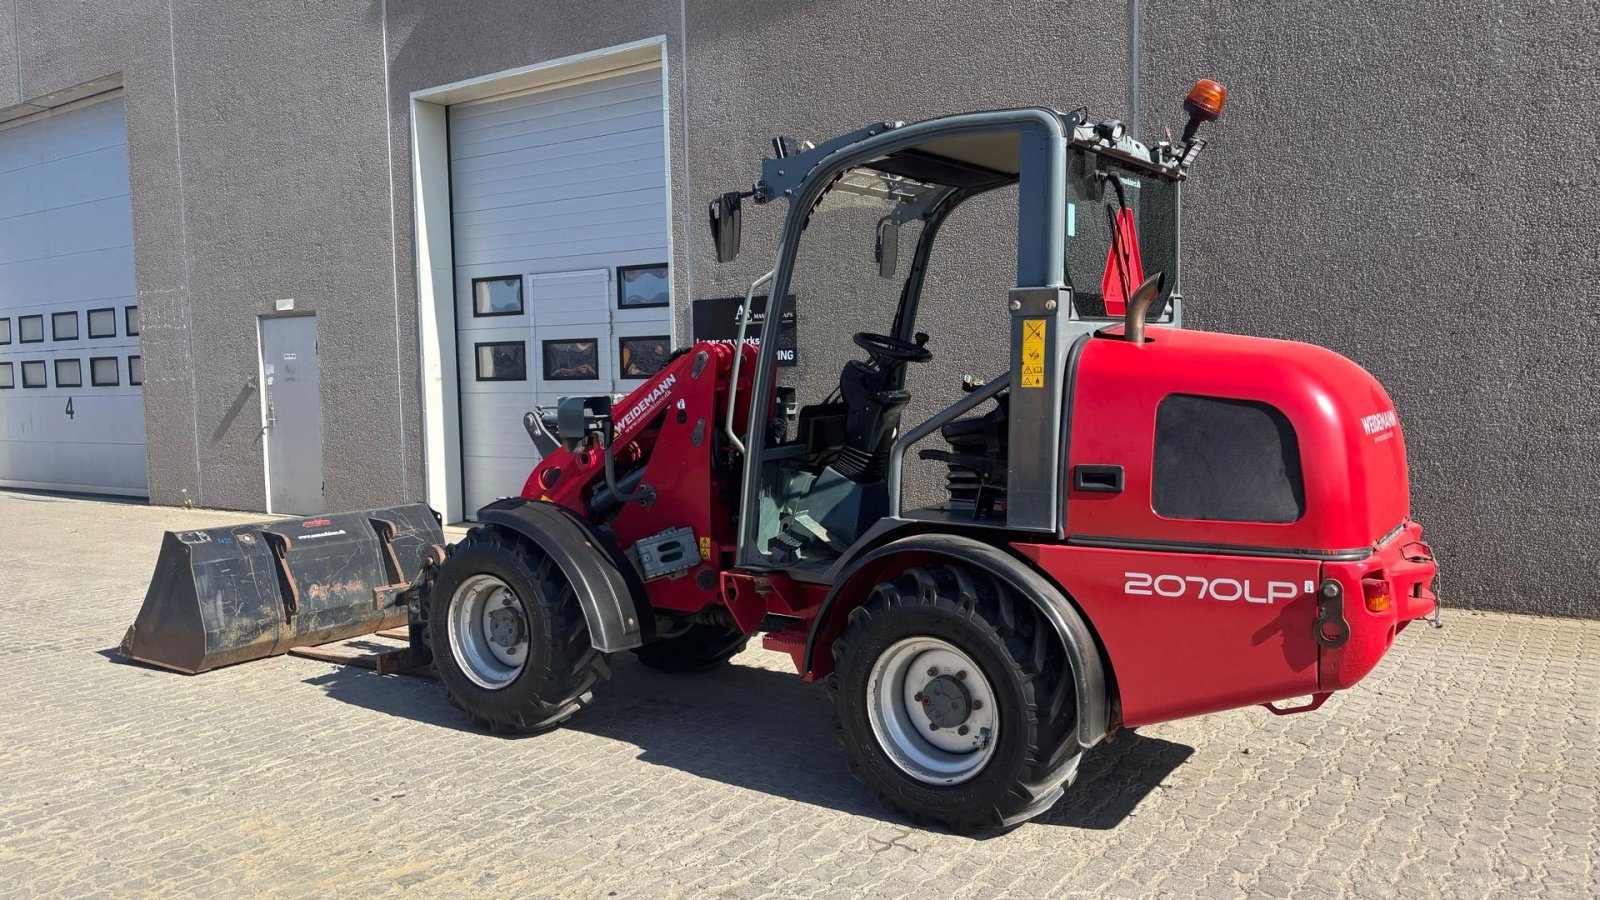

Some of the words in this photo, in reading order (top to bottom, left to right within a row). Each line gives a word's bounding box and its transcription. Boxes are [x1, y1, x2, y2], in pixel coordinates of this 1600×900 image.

[65, 396, 75, 420] 4
[614, 373, 677, 433] WEIDEMANN
[1360, 410, 1397, 436] WEIDEMANN
[1124, 571, 1298, 604] 2070LP
